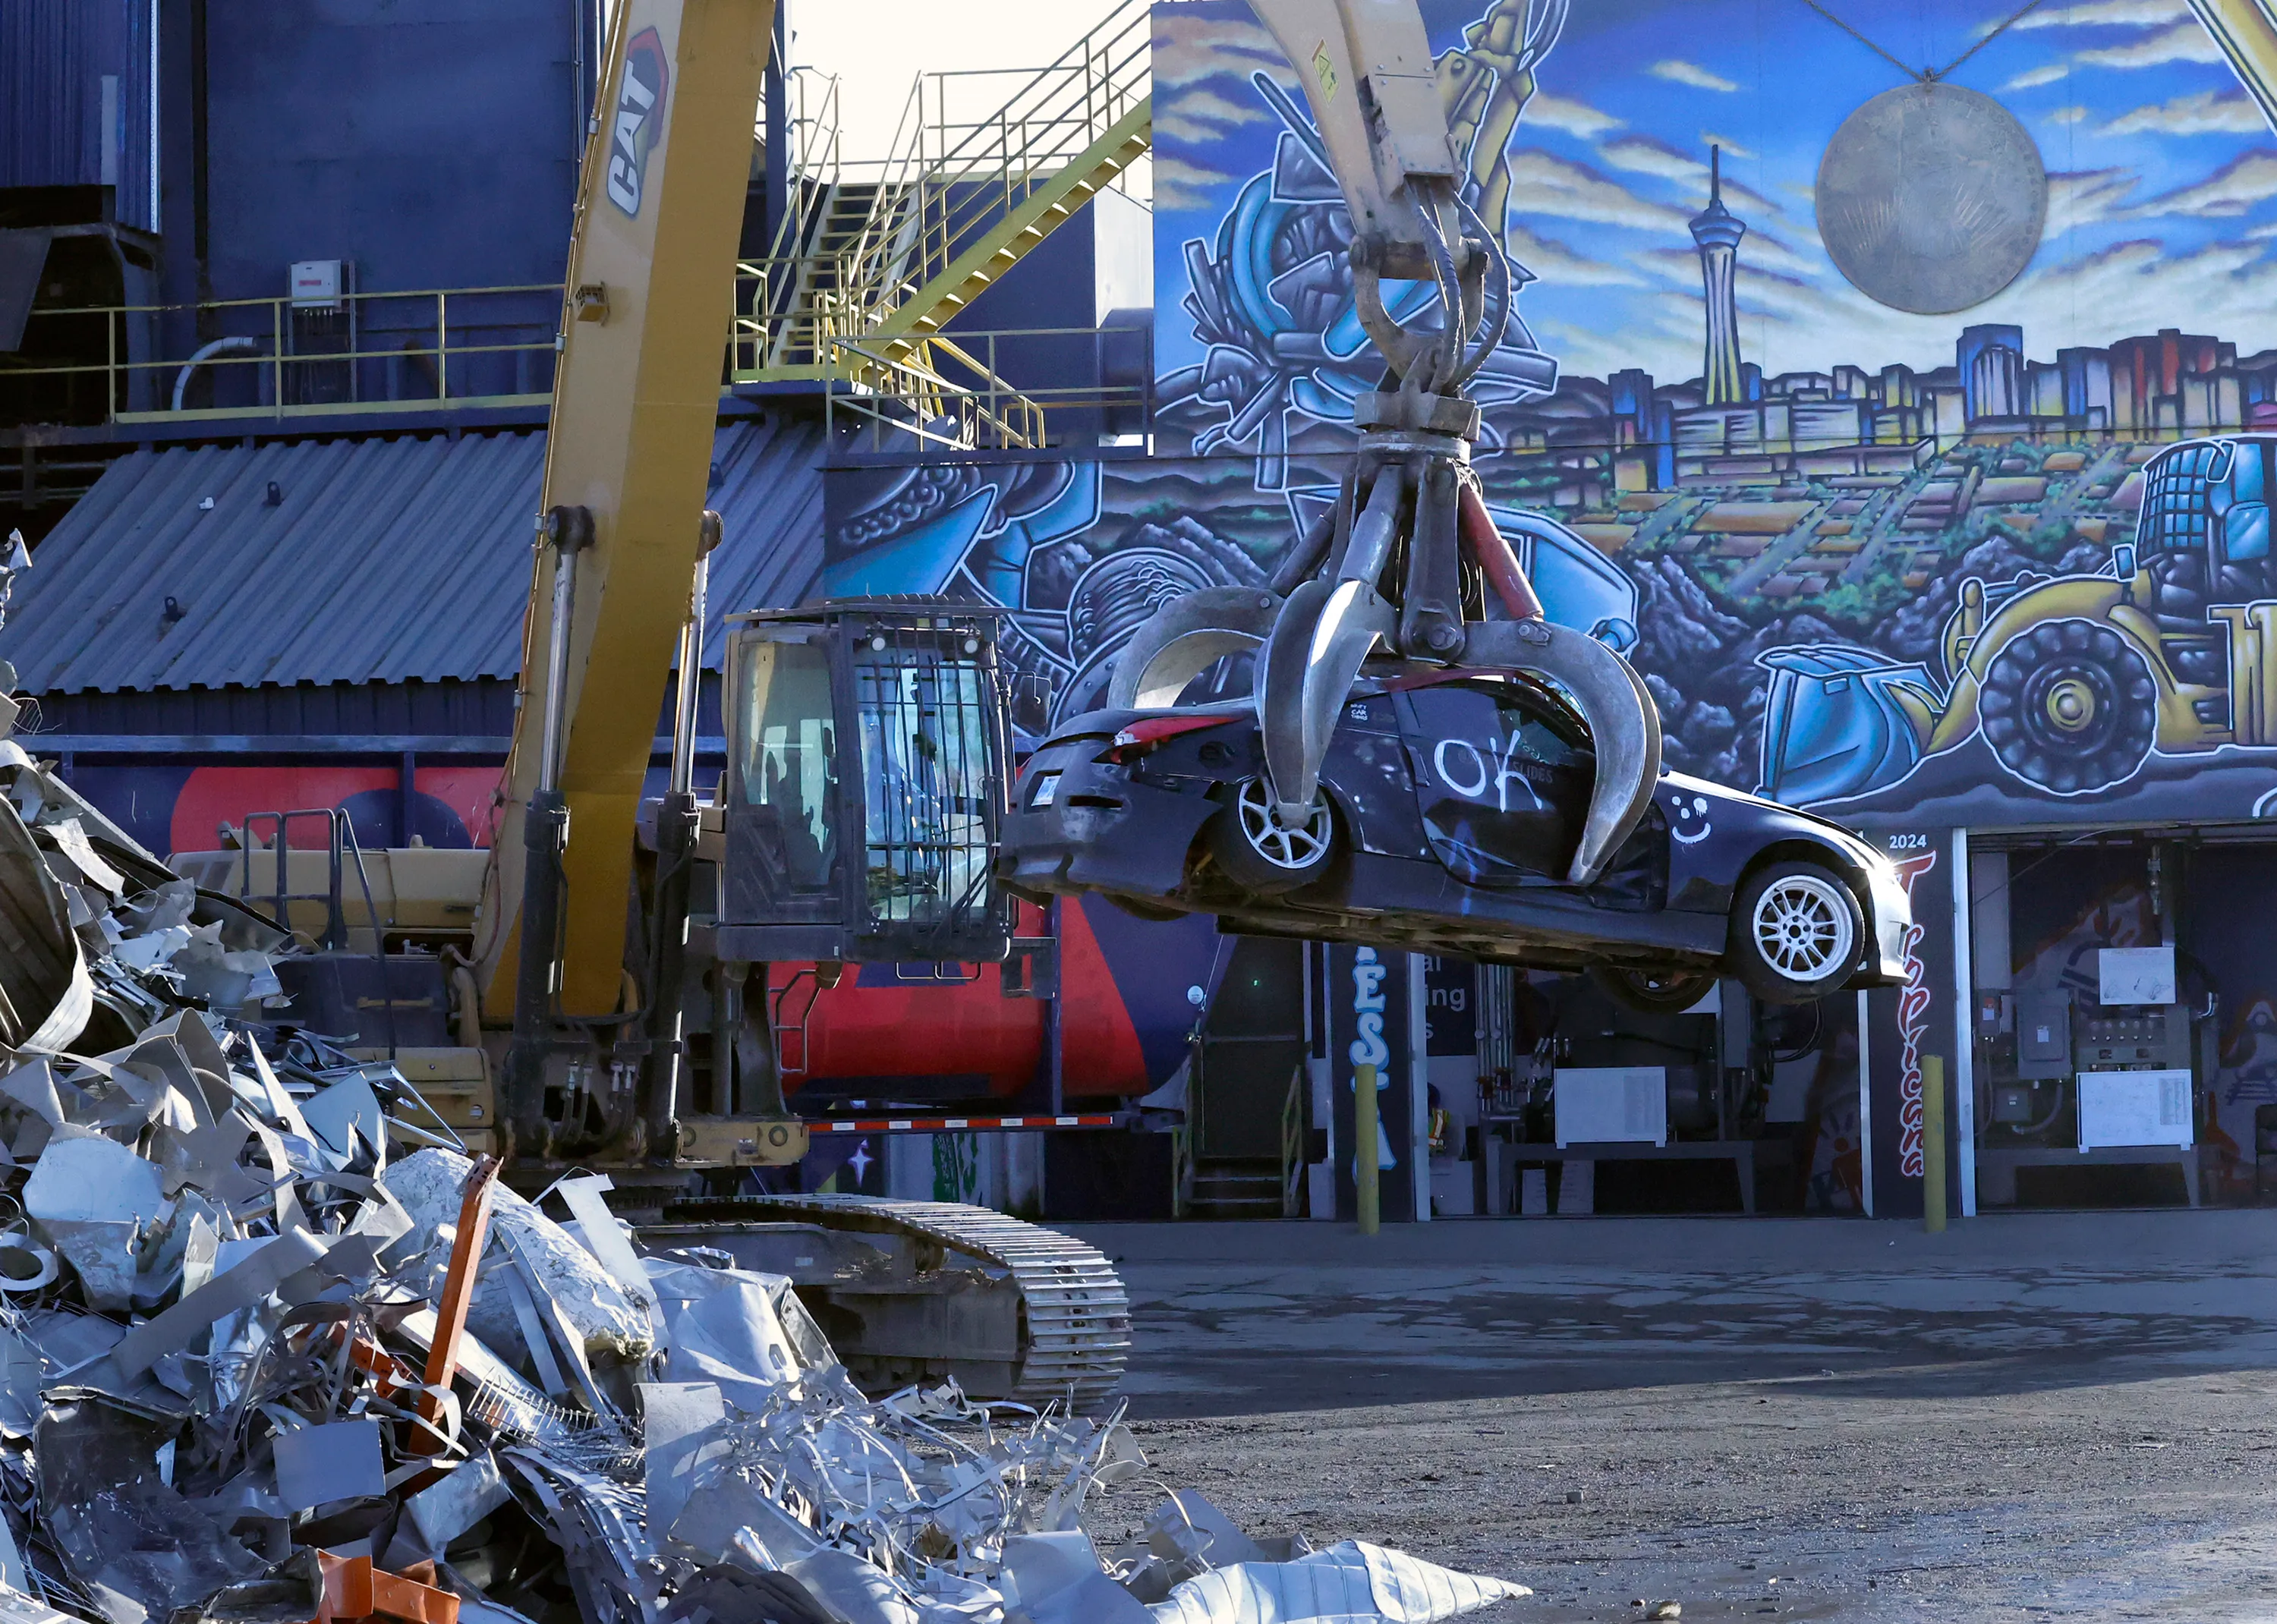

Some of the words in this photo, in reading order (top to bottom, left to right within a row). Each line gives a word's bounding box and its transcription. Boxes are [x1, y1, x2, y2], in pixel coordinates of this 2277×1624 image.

[607, 59, 656, 215] CAT
[1435, 729, 1542, 812] OK
[1888, 834, 1927, 849] 2024
